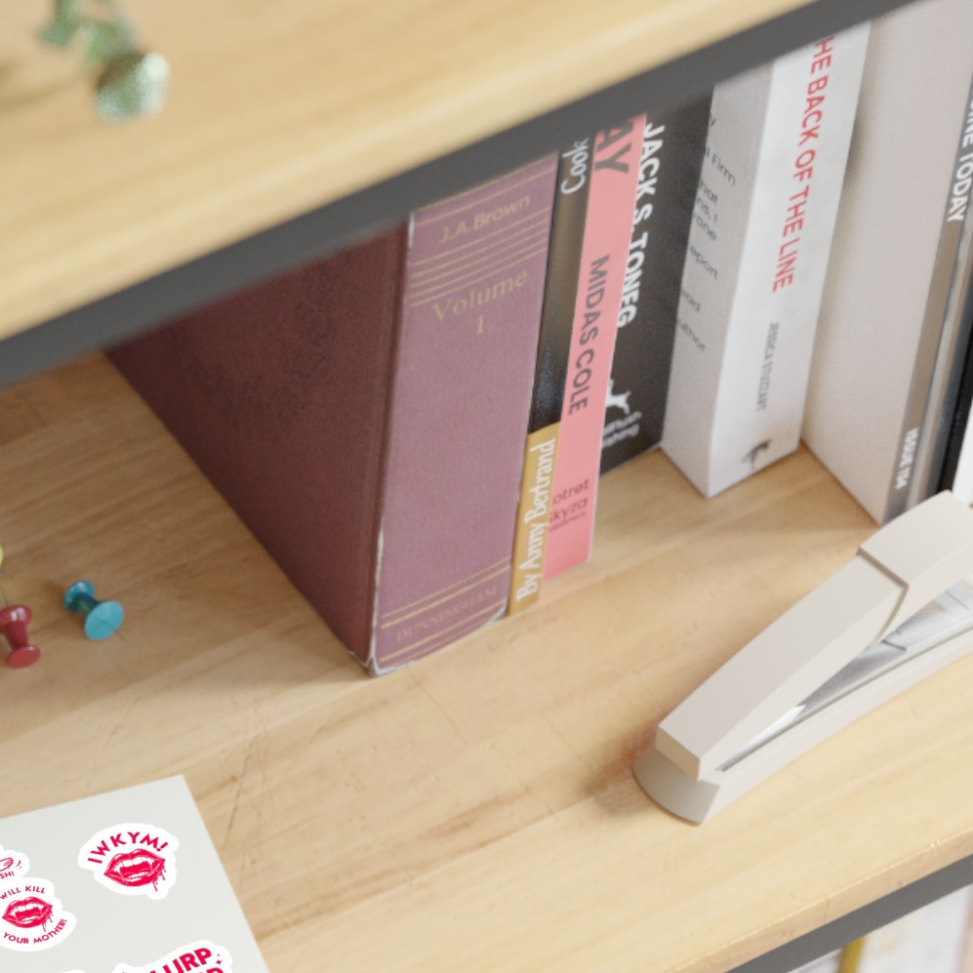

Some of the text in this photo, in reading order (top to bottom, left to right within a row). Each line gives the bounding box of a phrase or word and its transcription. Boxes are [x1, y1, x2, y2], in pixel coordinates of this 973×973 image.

[560, 137, 589, 194] Cook
[635, 122, 665, 200] JACK
[772, 34, 835, 293] HE BACK OF THE LINE
[947, 150, 973, 222] TODAY
[433, 272, 527, 322] Volume
[568, 254, 610, 415] MIDAS COLE
[524, 437, 556, 523] Bertrand
[515, 573, 543, 601] By
[87, 831, 169, 864] IWKYM!
[25, 885, 45, 894] KILL
[3, 918, 68, 944] YOUR MOTHER!
